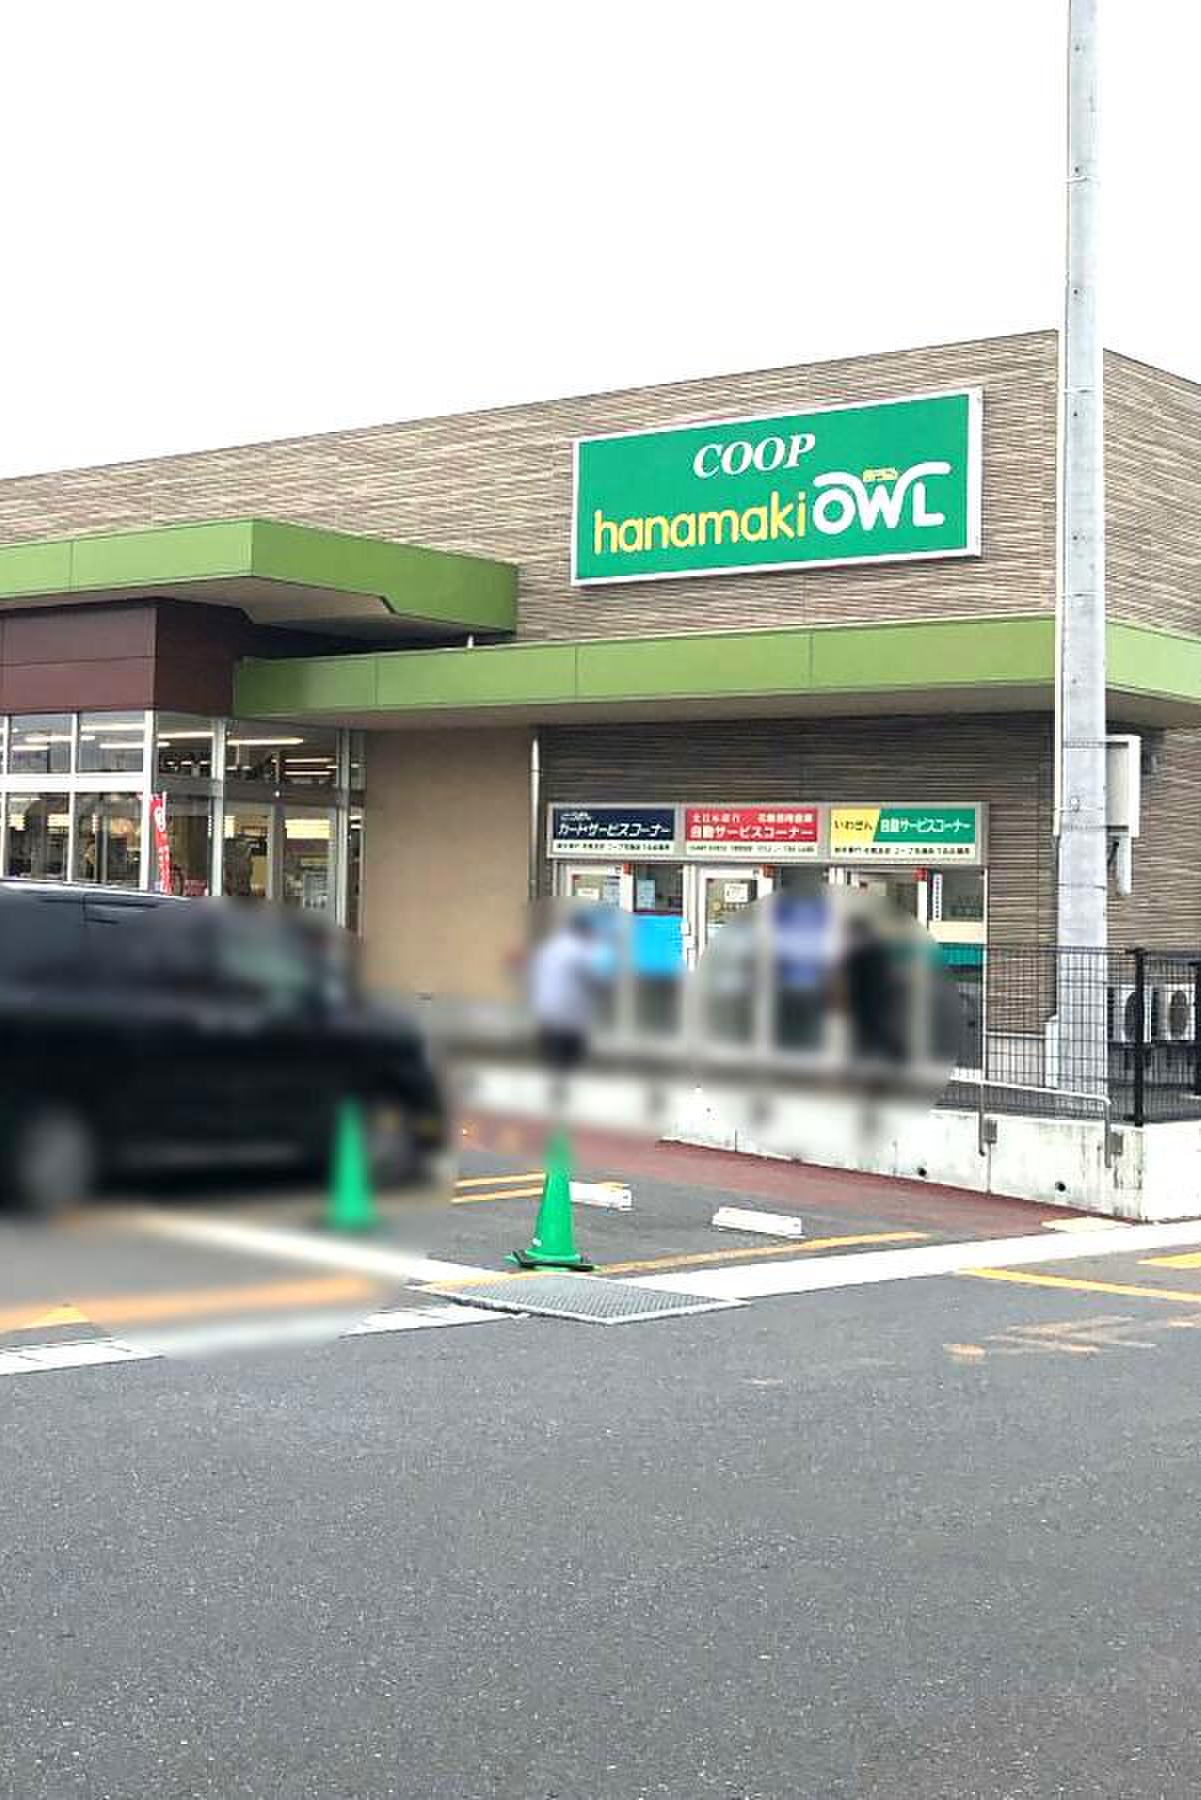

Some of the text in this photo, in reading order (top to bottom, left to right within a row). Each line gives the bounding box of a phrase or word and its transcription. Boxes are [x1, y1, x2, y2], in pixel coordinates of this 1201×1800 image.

[693, 433, 816, 479] COOP
[593, 461, 951, 554] hanamaki OWL
